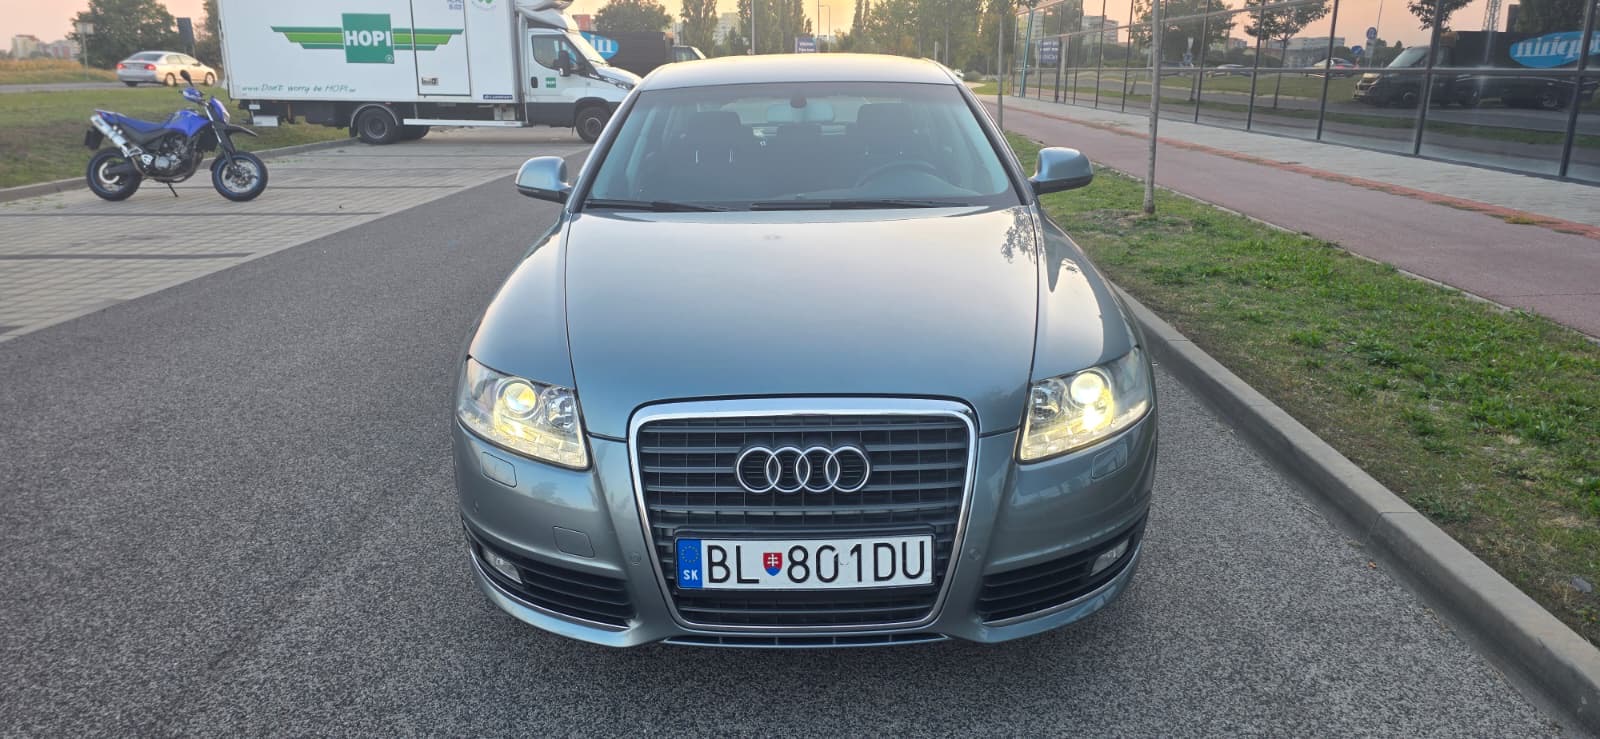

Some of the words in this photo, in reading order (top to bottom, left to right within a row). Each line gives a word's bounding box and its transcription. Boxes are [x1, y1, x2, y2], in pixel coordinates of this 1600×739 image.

[345, 30, 392, 47] HOPI
[707, 545, 760, 584] BL
[787, 541, 925, 584] 801DU
[683, 569, 699, 581] SK
